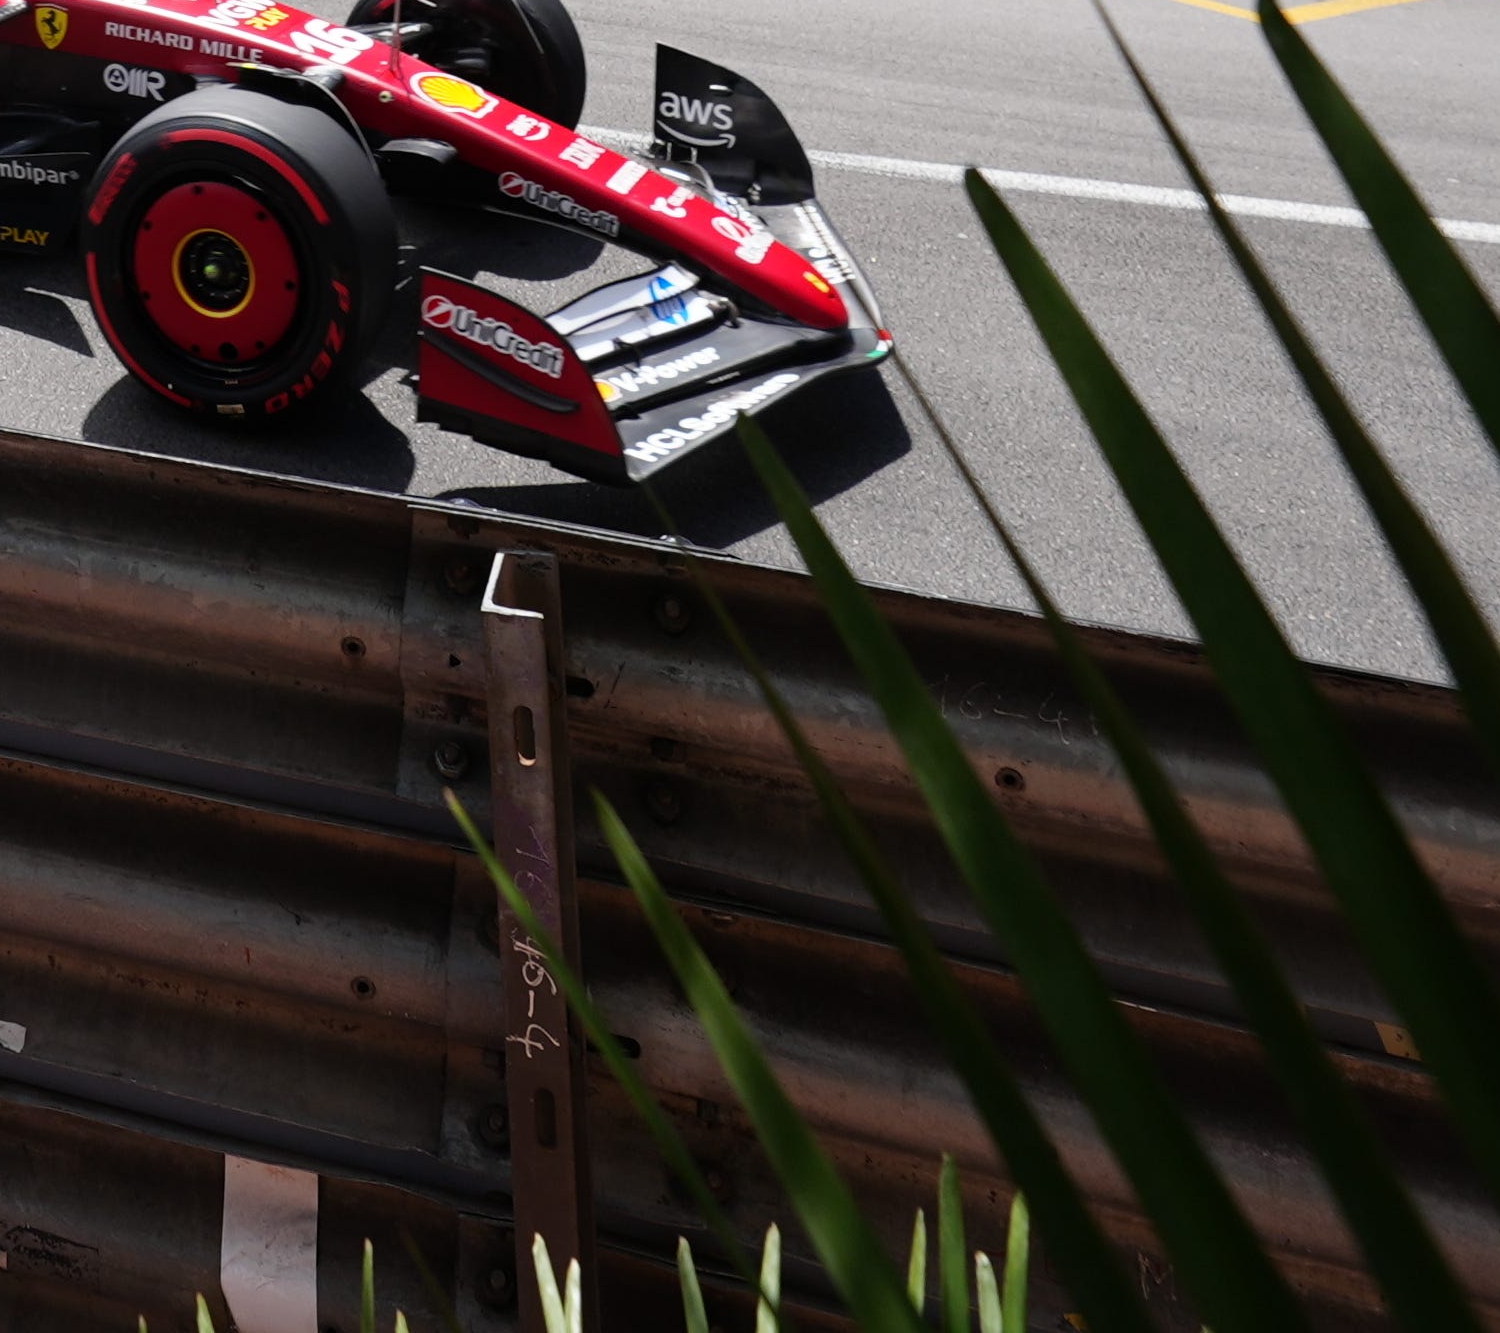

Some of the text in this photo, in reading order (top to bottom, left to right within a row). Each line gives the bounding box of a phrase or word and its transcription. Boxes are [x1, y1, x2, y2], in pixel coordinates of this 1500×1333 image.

[105, 21, 264, 63] RICHARD MILLE
[289, 17, 375, 65] 16
[658, 90, 734, 132] aws
[523, 182, 620, 238] UniCredit
[0, 225, 50, 246] PLAY
[452, 305, 564, 380] UniCredit
[612, 345, 721, 393] V-Power
